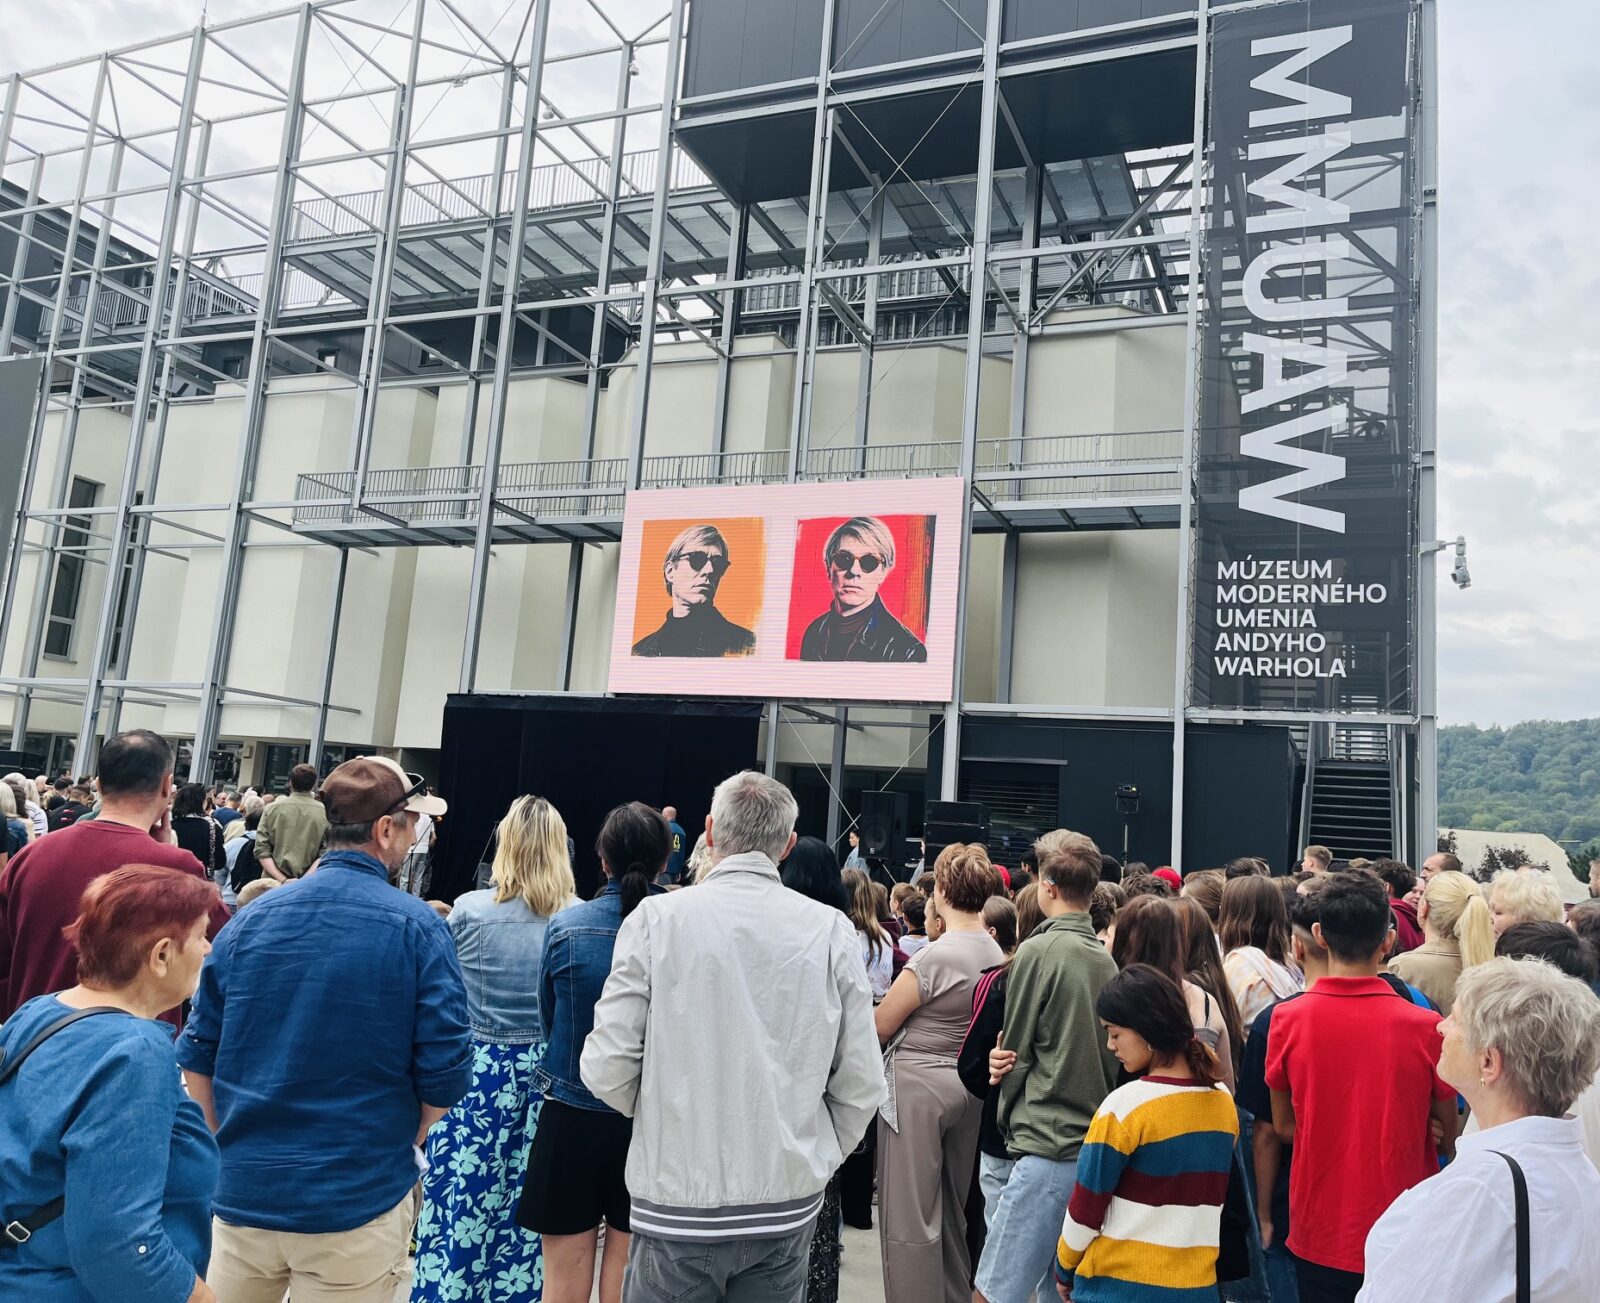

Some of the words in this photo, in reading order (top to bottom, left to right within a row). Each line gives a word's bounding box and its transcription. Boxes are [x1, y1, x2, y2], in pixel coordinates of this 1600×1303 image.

[1239, 24, 1353, 534] MMUAW
[1217, 554, 1332, 580] MÚZEUM
[1216, 577, 1387, 604] MODERNÉHO
[1216, 608, 1317, 628] UMENIA
[1214, 632, 1326, 653] ANDYHO
[1214, 656, 1347, 678] WARHOLA
